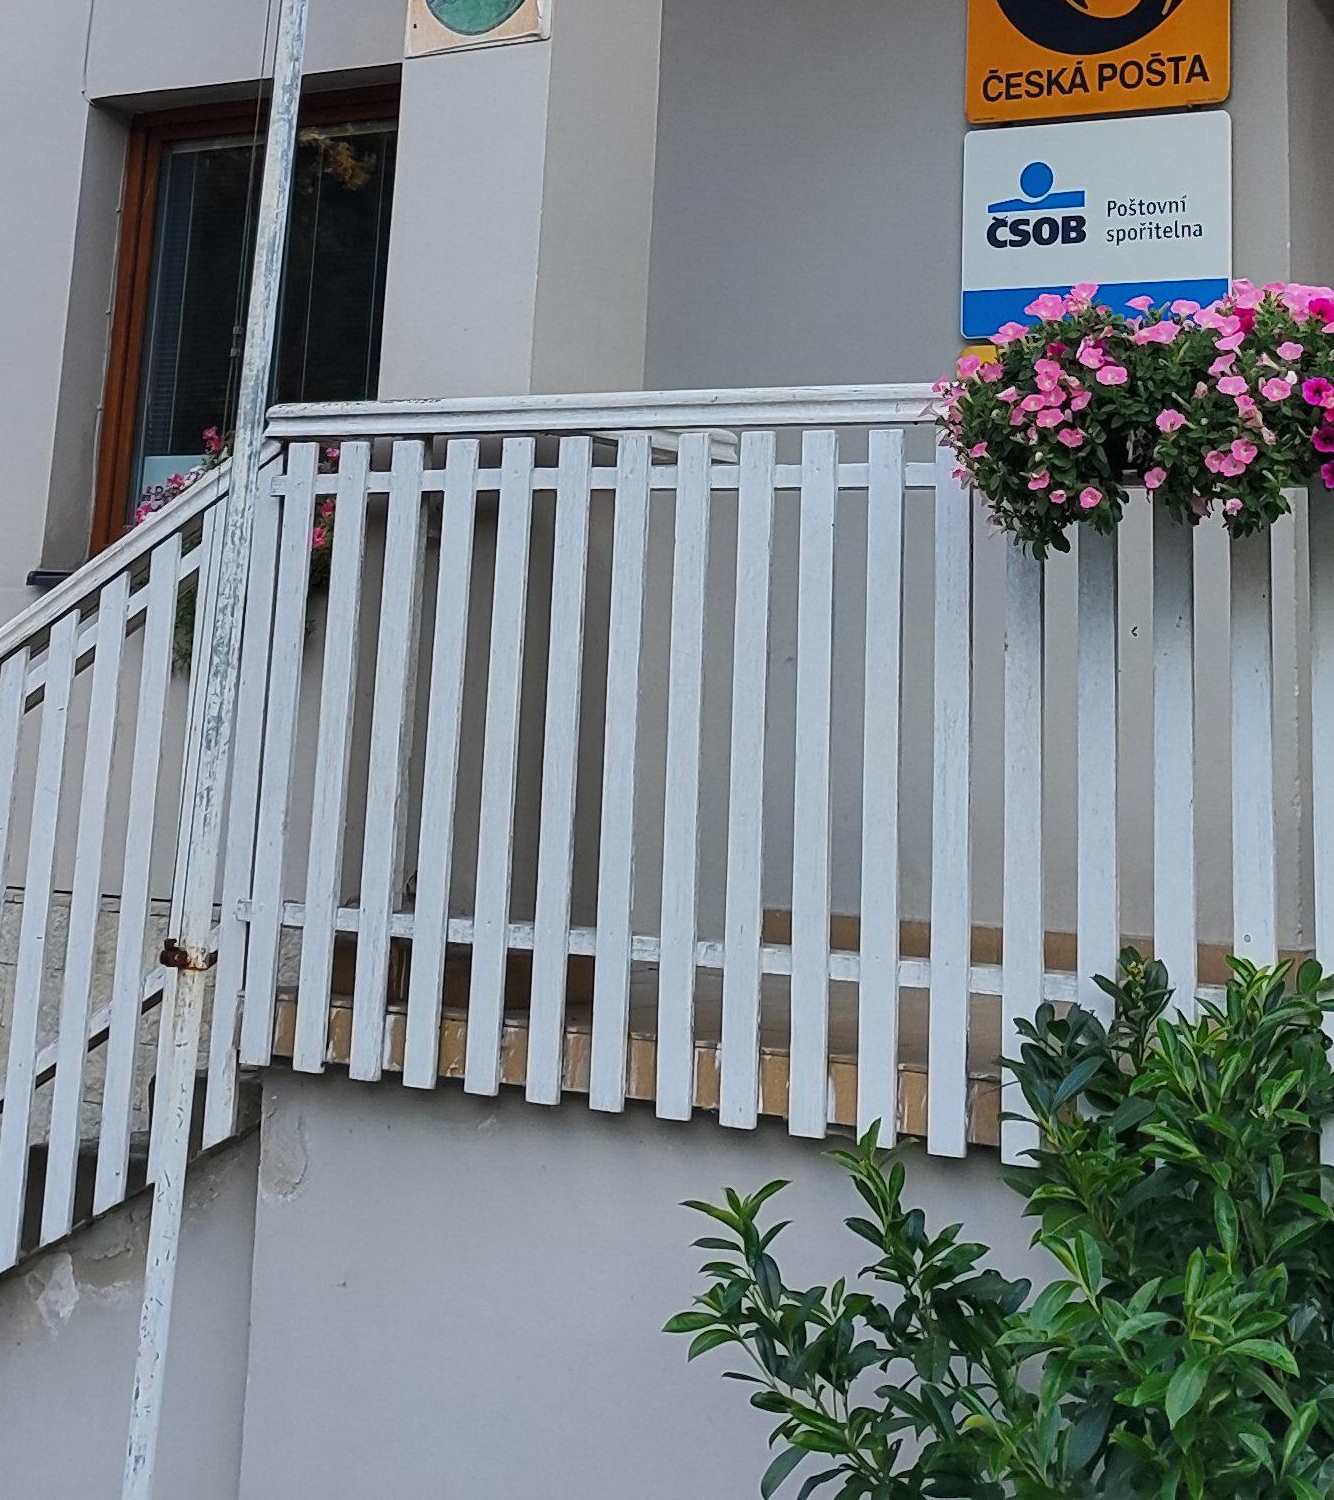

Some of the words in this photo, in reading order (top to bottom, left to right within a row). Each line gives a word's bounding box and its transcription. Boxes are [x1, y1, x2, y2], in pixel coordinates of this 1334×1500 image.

[982, 60, 1090, 102] ČESKÁ
[1098, 52, 1210, 92] POŠTA
[1107, 194, 1187, 217] Poštovní
[986, 215, 1087, 248] ČSOB
[1106, 220, 1203, 246] spořitelna
